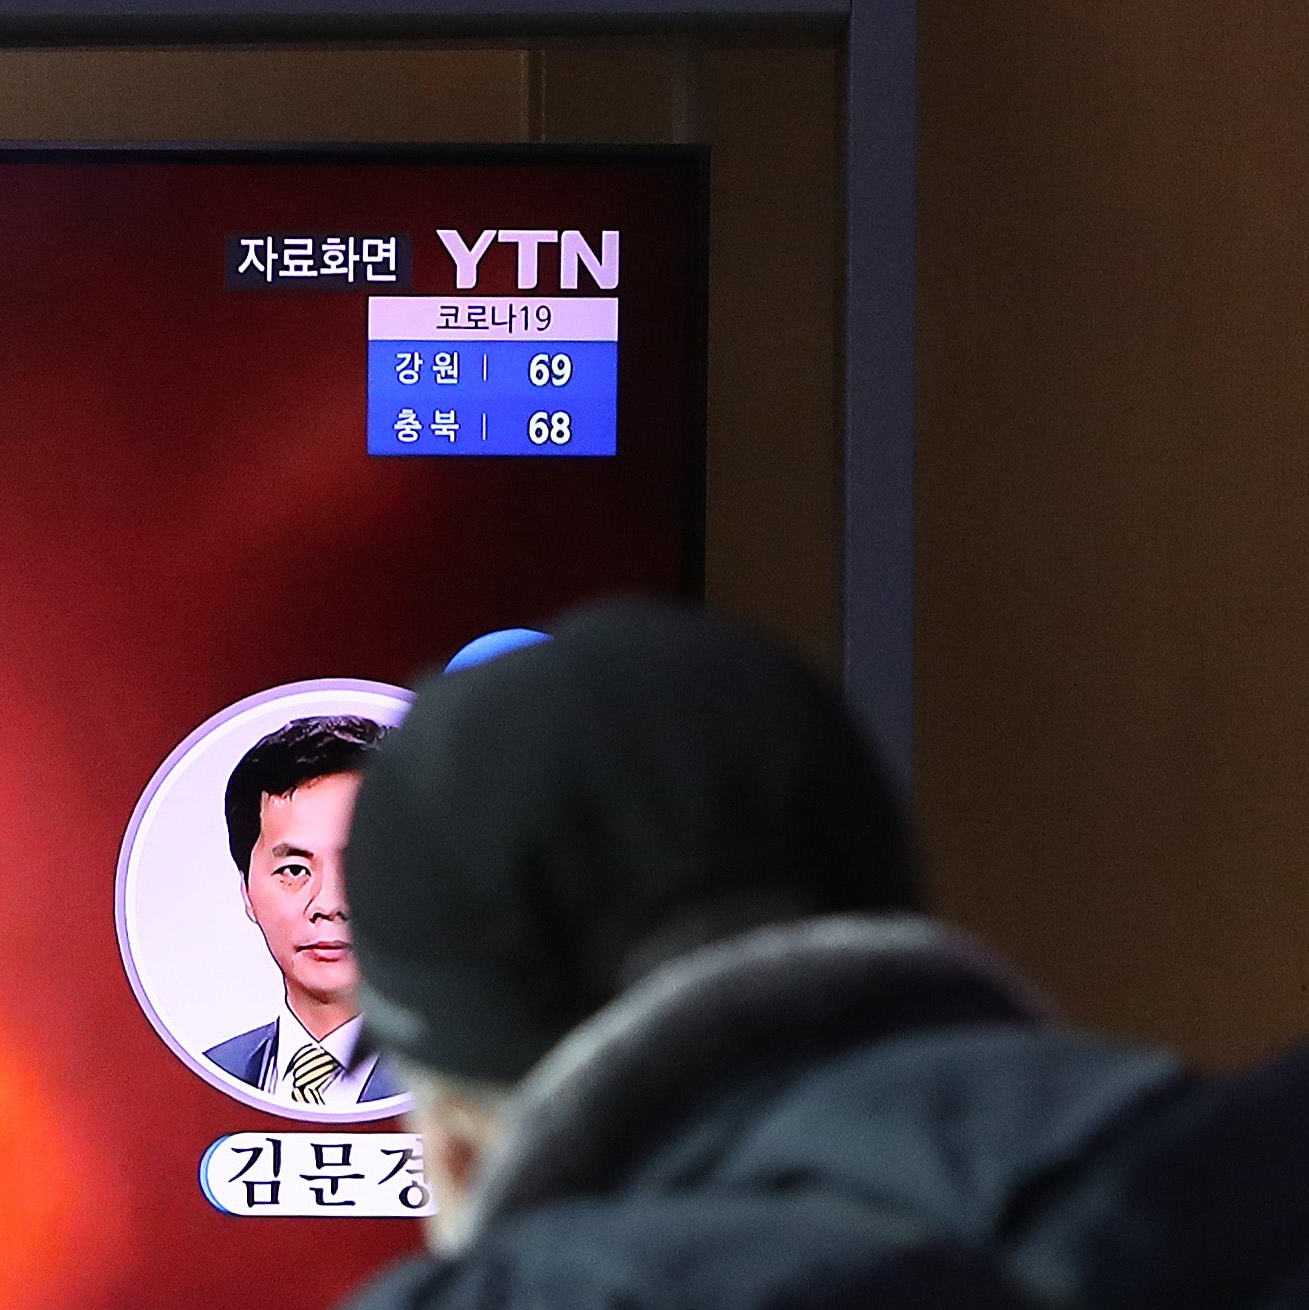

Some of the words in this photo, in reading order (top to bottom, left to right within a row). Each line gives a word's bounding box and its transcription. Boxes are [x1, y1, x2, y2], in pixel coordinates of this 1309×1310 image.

[237, 235, 398, 284] 자료화면
[435, 229, 620, 290] YTN
[435, 303, 553, 335] 코로나19
[528, 353, 573, 387] 69
[527, 411, 572, 444] 68
